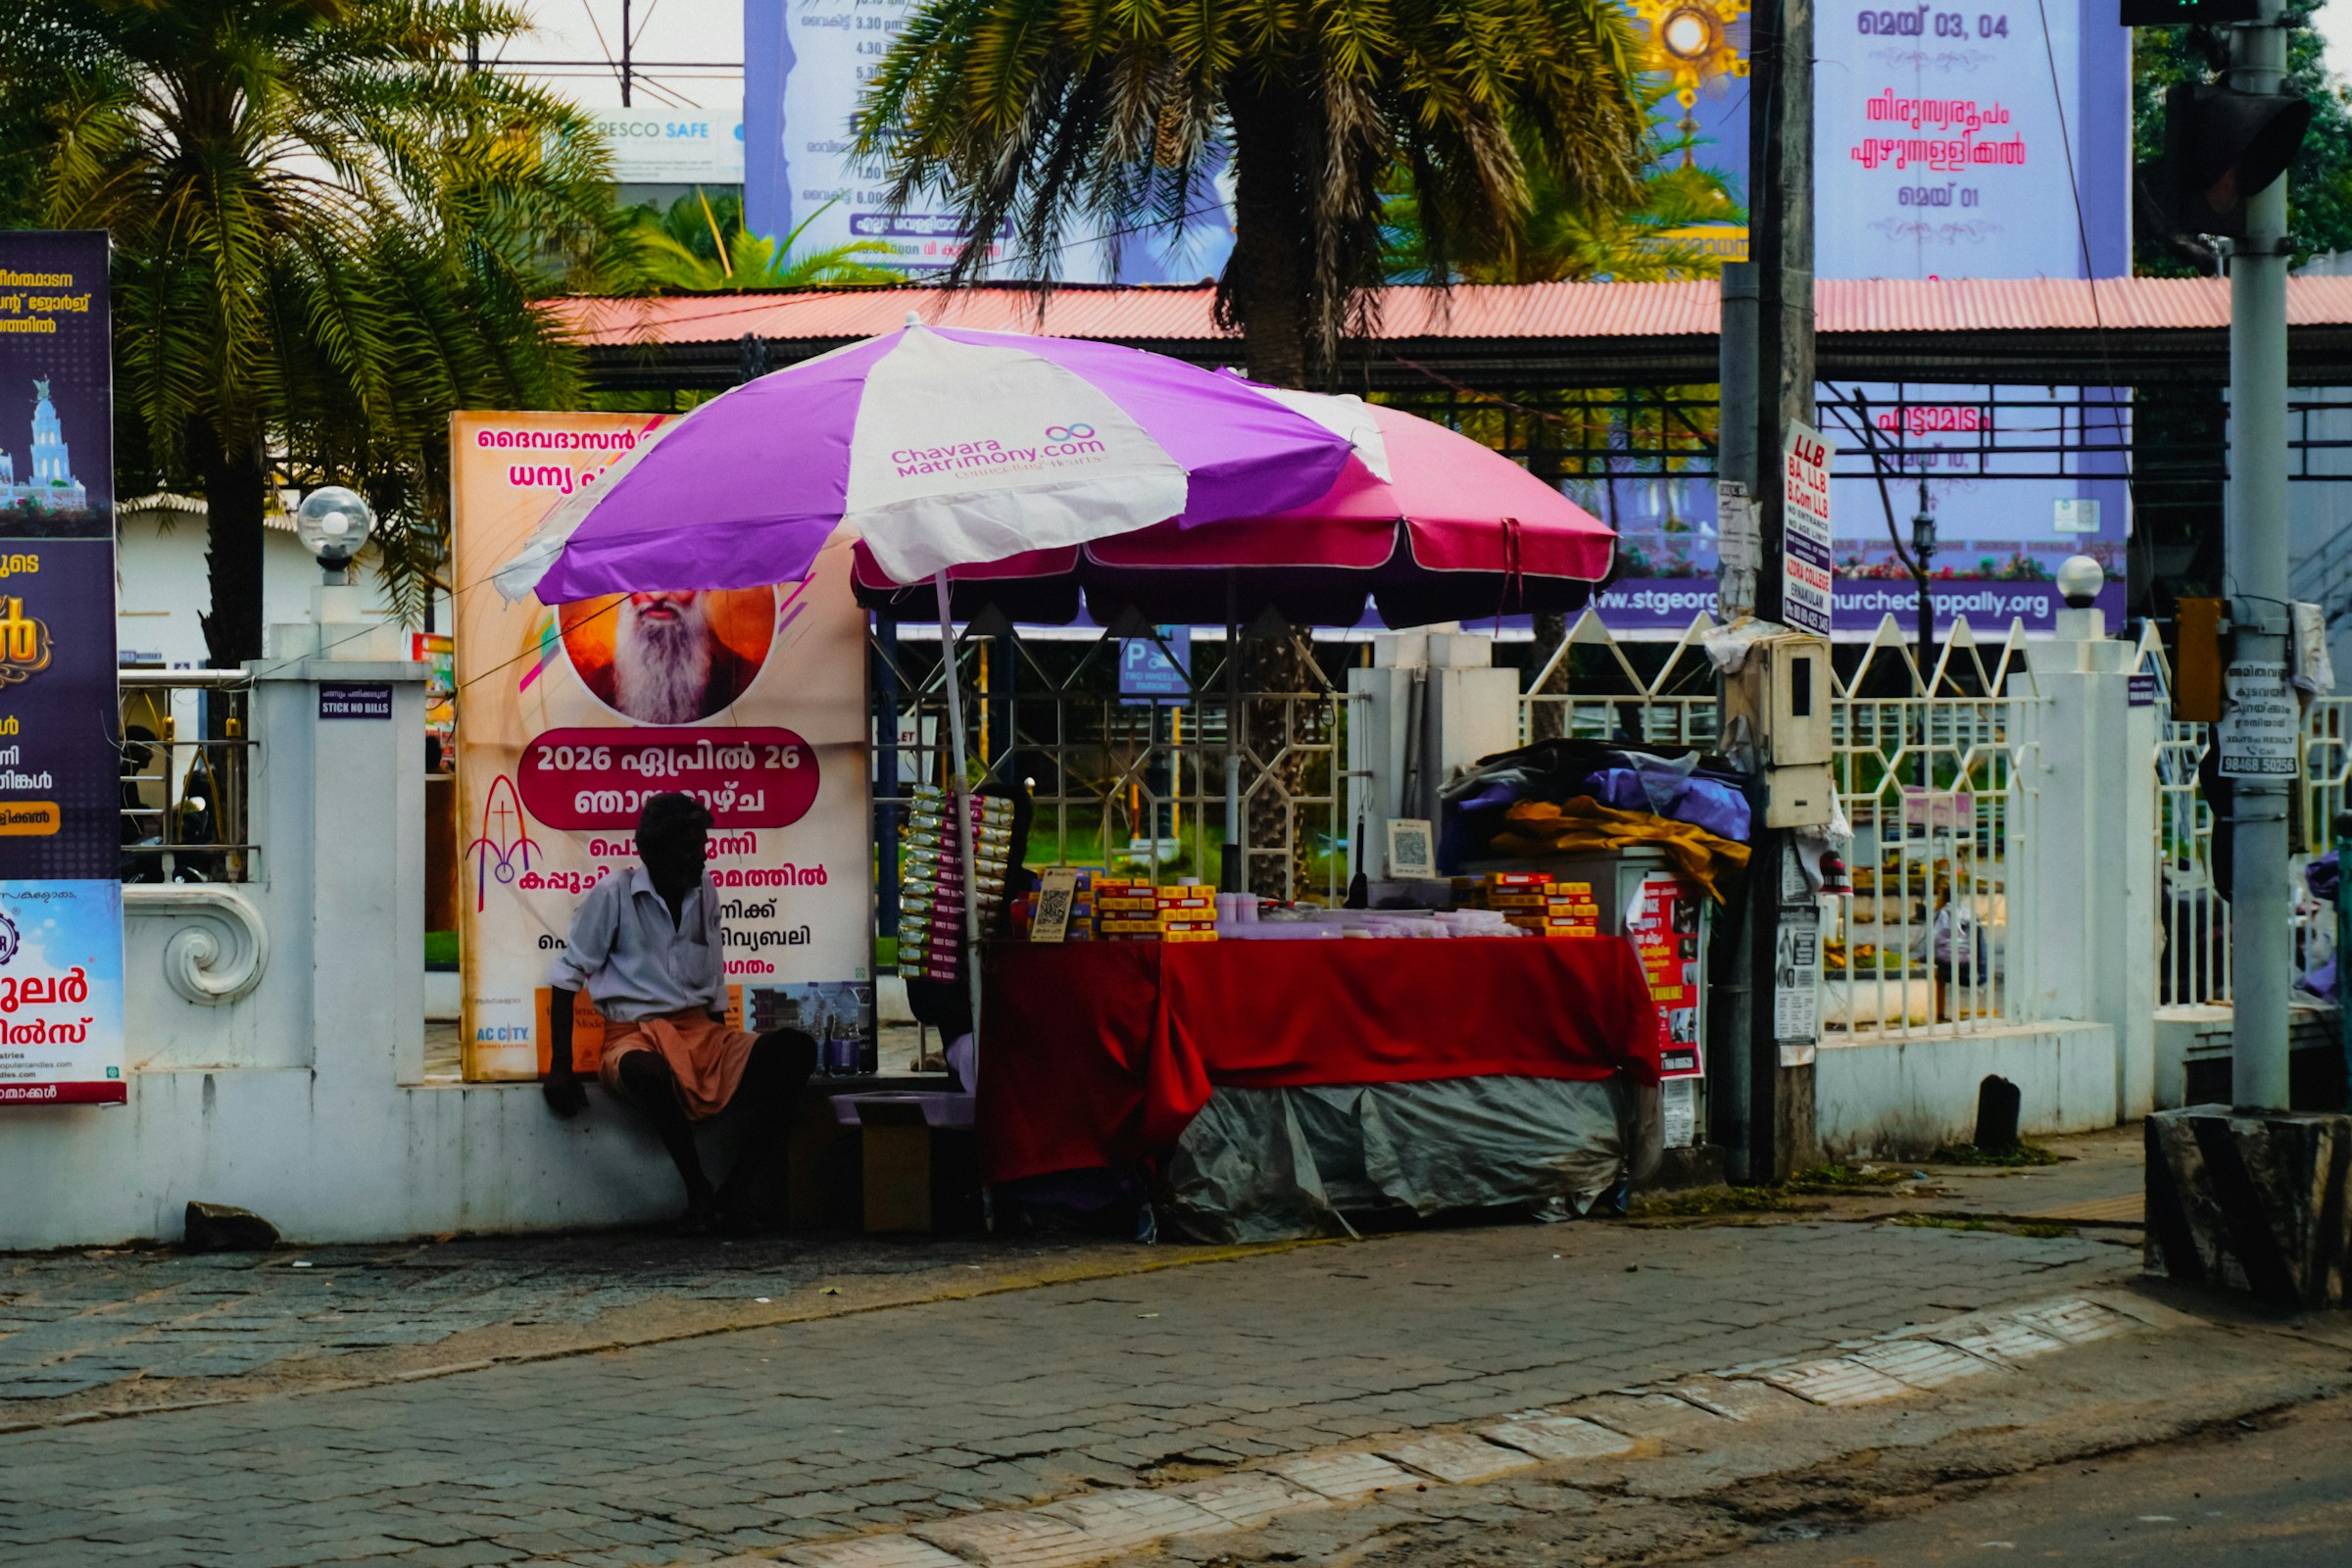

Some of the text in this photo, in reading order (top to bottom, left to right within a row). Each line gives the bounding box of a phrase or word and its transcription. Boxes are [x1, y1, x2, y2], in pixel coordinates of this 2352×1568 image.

[856, 16, 881, 29] 3.30
[1858, 5, 2009, 40] മെയ് 03, 04
[856, 41, 881, 55] 4.30
[588, 122, 709, 138] RESCO SAFE
[857, 190, 882, 204] 6.00
[1898, 180, 1979, 207] മെയ് 01
[0, 316, 57, 333] ത്തിൽ
[478, 429, 636, 450] ദൈവദാസൻ
[891, 439, 1002, 464] Chavara
[1794, 434, 1825, 467] LLB
[897, 440, 1105, 477] Matrimony.com
[510, 466, 573, 494] ധന്യ
[1788, 456, 1826, 494] BA. LLB
[1788, 504, 1829, 532] NO ENTRANCE
[1814, 493, 1828, 518] LLB
[1788, 517, 1828, 544] NO AGE LIMIT
[1805, 566, 1830, 593] COLLEGE
[1791, 582, 1825, 610] ERNAKULAM
[1128, 642, 1146, 669] P
[322, 703, 389, 713] STICK NO BILLS
[537, 739, 800, 777] 2026 ഏപ്രിൽ 26
[2226, 758, 2294, 772] 98468 50256
[476, 1028, 494, 1041] AC
